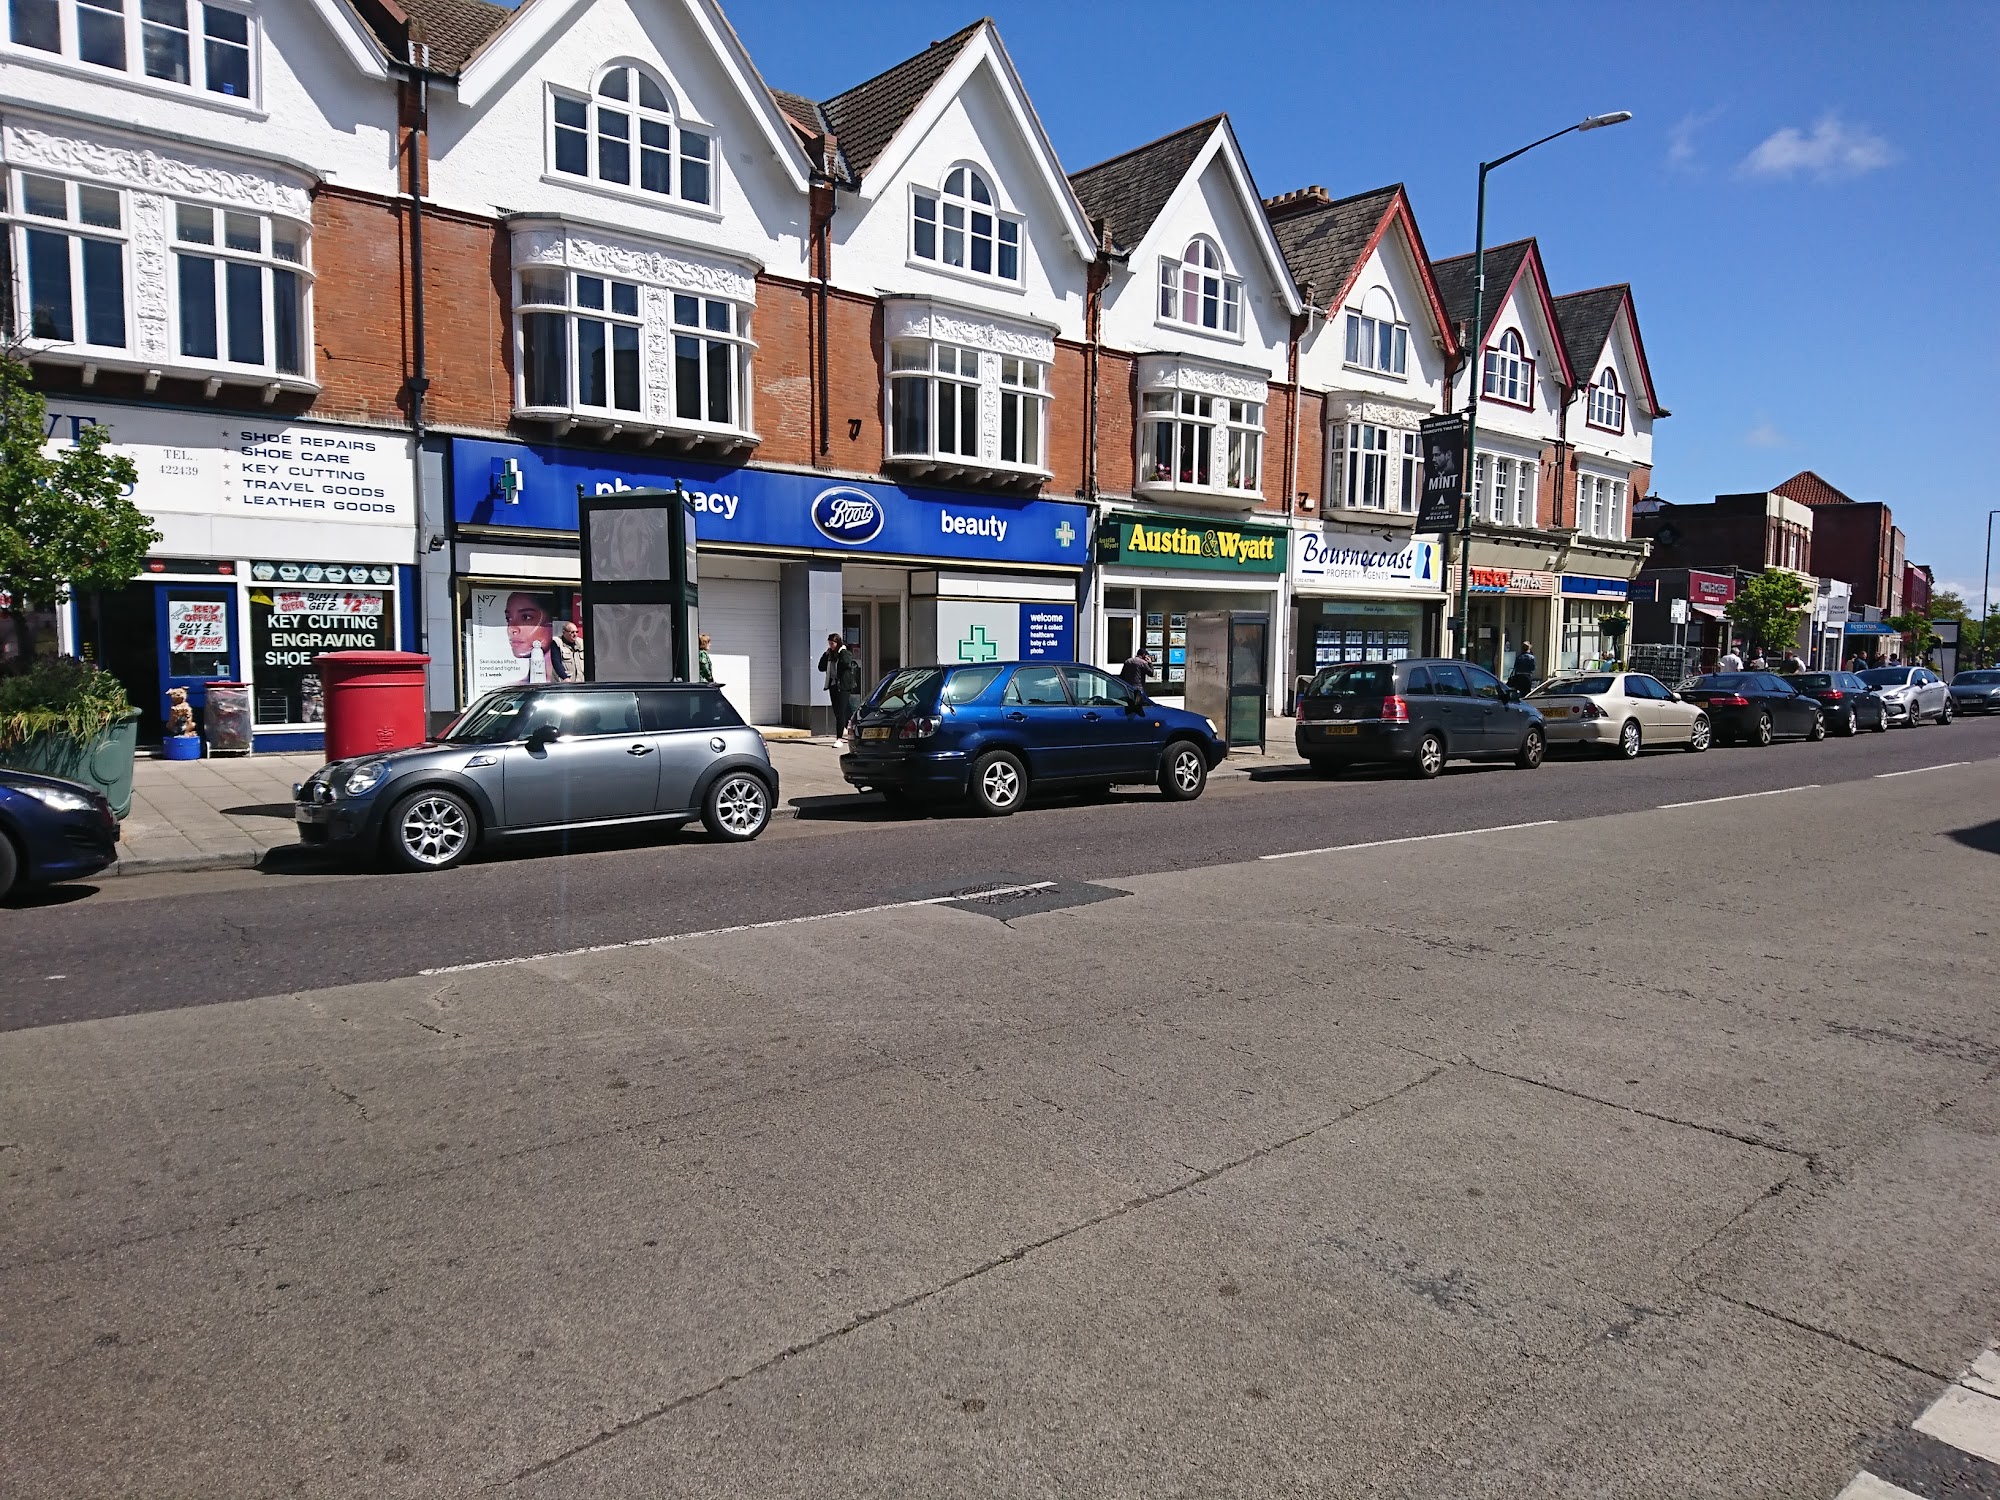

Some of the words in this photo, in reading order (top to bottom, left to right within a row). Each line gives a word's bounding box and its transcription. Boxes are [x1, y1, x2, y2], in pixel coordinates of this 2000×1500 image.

[241, 431, 292, 444] SHOE
[300, 437, 376, 451] REPAIRS
[241, 446, 292, 460] SHOE
[301, 452, 350, 464] CARE
[159, 465, 199, 476] 422439
[242, 463, 279, 474] KEY
[289, 467, 365, 481] CUTTING
[243, 479, 314, 493] TRAVEL
[322, 485, 384, 498] GOODS
[1428, 474, 1459, 490] MINT
[243, 495, 325, 508] LEATHER
[333, 501, 395, 513] GOODS
[824, 499, 874, 529] Boots
[941, 509, 1008, 542] beauty
[1299, 533, 1414, 570] Bournecoast
[1326, 569, 1360, 579] PROPERTY
[1362, 571, 1389, 580] AGENTS
[1472, 569, 1508, 587] TESCO
[1510, 573, 1544, 592] express
[307, 592, 331, 602] BUY
[193, 604, 220, 614] KEY
[280, 600, 306, 612] OFFER
[308, 602, 327, 611] GET
[267, 615, 300, 629] KEY
[308, 615, 378, 630] CUTTING
[1030, 612, 1064, 622] welcome
[180, 628, 200, 636] GET
[271, 633, 376, 648] ENGRAVING
[265, 652, 312, 666] SHOE
